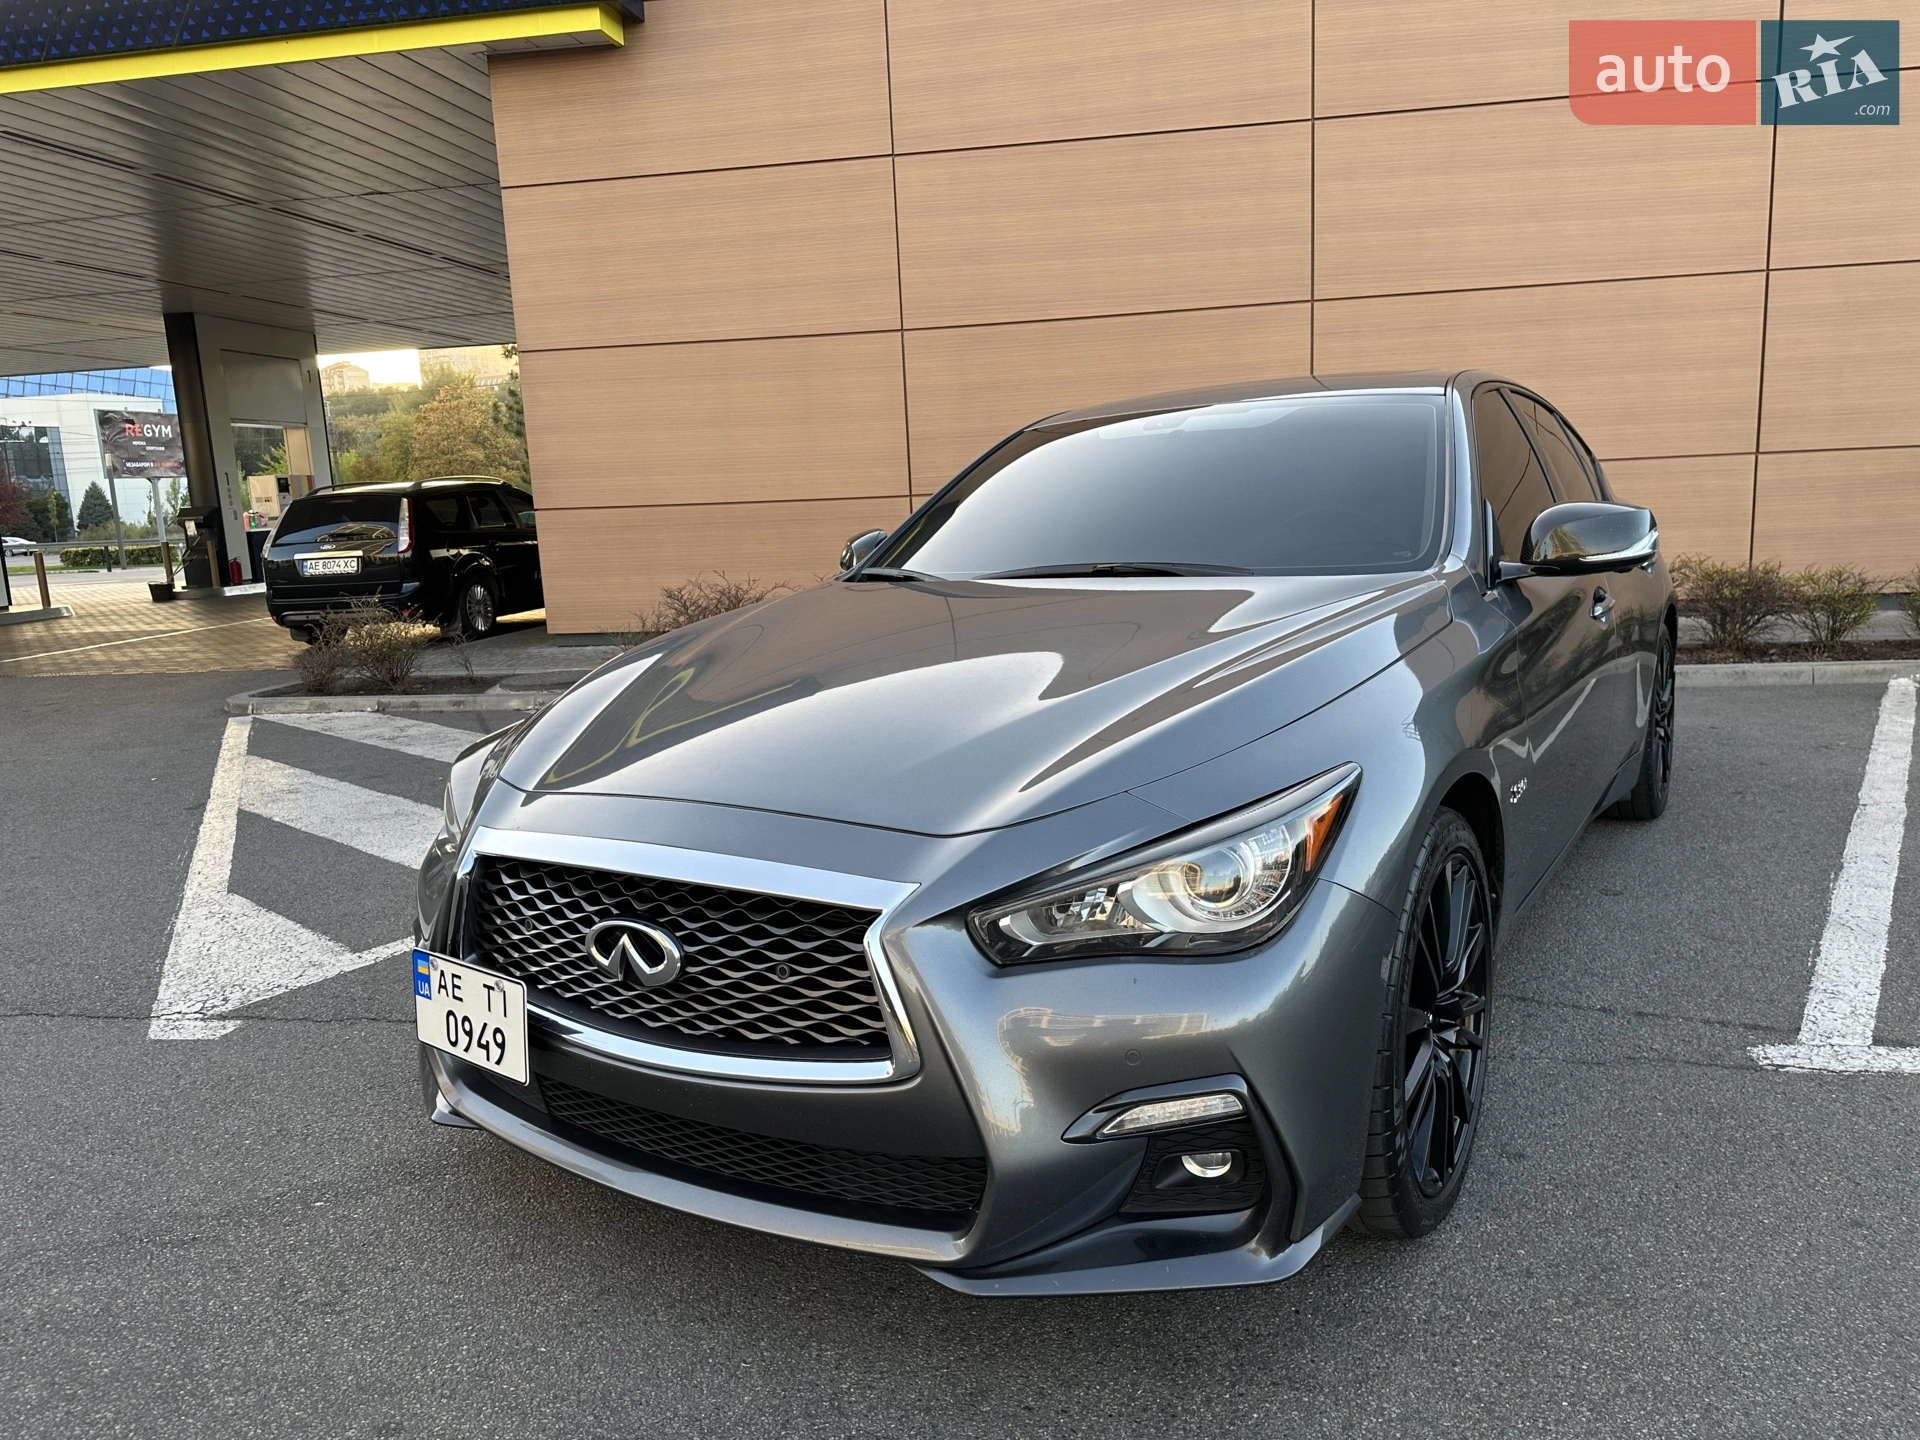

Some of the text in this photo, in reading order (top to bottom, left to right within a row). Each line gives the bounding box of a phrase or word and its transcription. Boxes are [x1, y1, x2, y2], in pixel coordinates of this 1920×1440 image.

[308, 559, 356, 571] AE 8074 XC
[418, 980, 431, 997] UA
[437, 969, 507, 1018] AE TI
[446, 1009, 506, 1066] 0949
